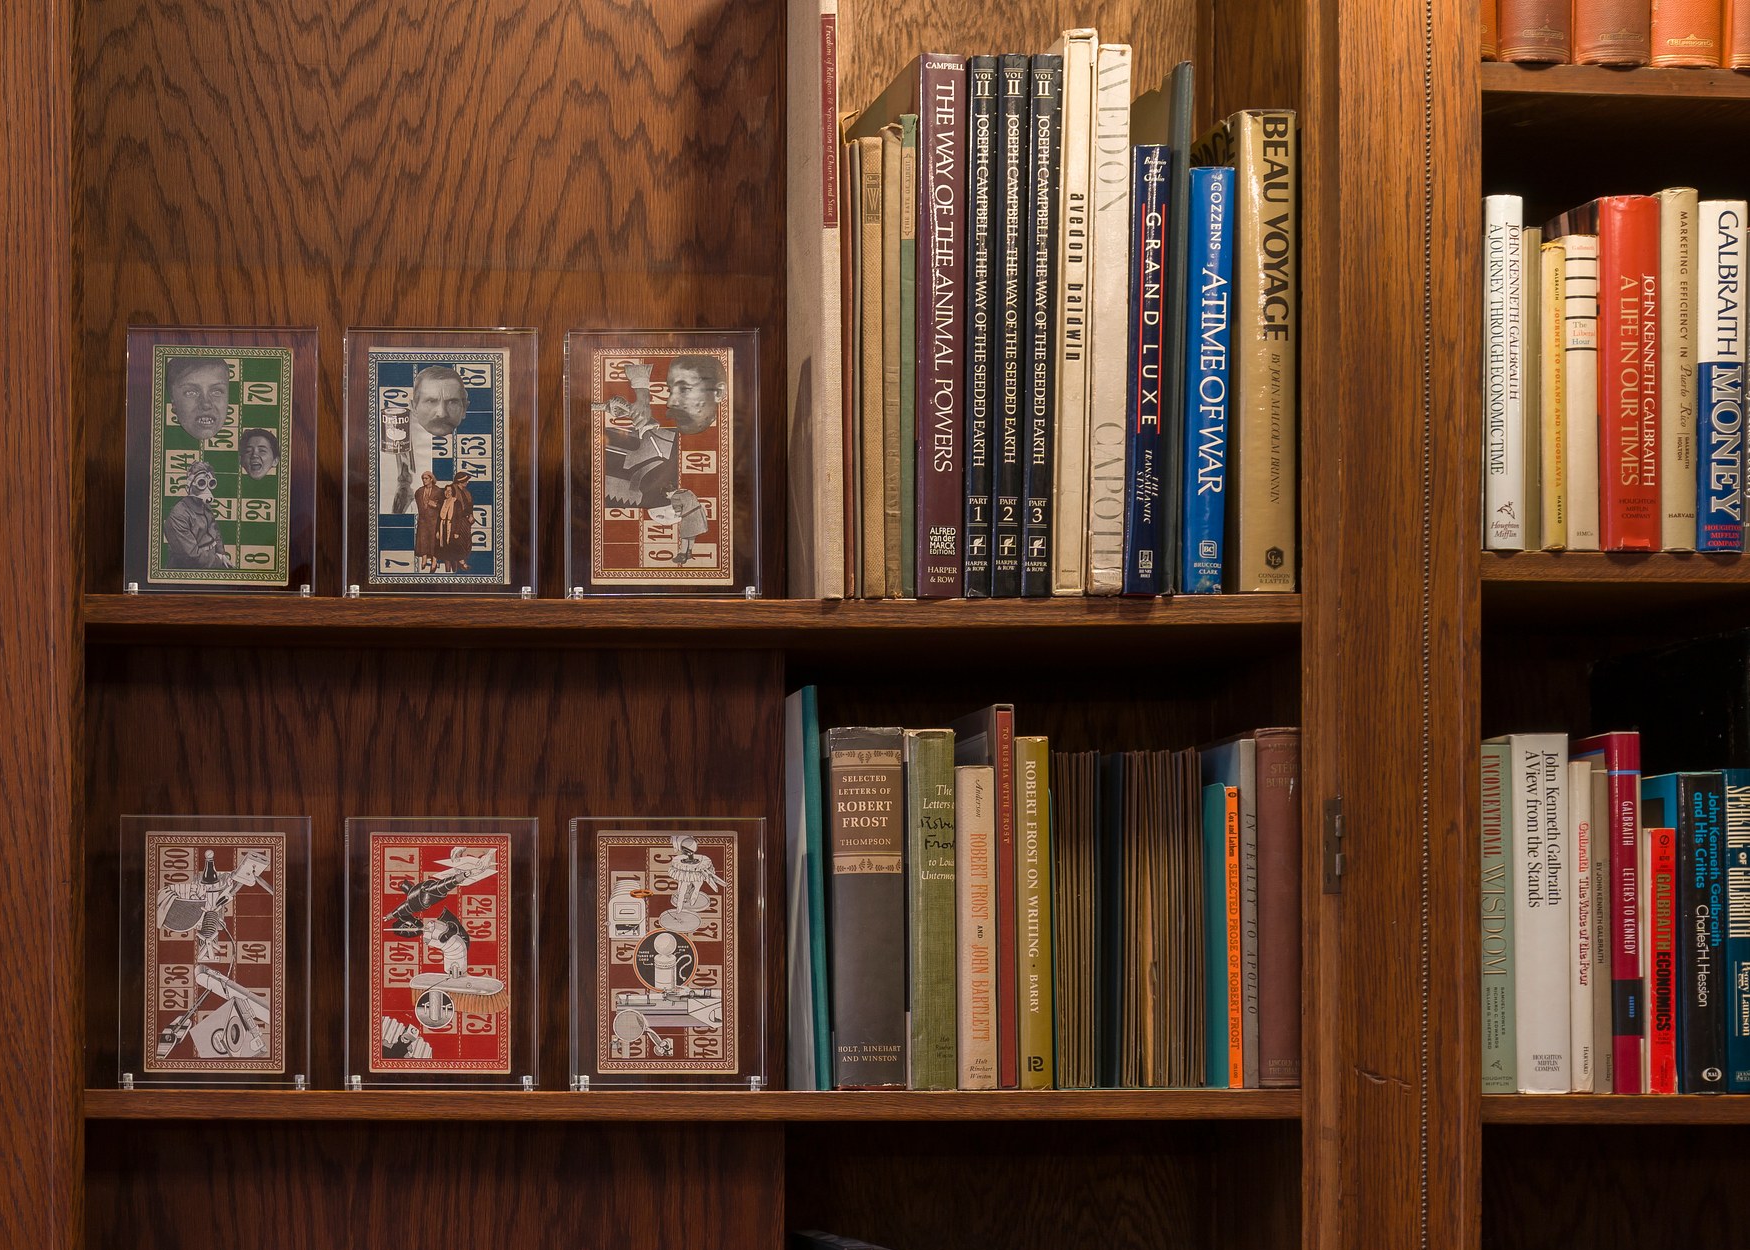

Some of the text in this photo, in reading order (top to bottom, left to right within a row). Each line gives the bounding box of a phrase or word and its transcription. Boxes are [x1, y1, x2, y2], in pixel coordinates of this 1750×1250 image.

[1262, 116, 1290, 342] BEAU VOYAGE
[933, 81, 955, 473] THE WAY OF THE ANIMAL POWERS
[1066, 193, 1086, 361] avedon baldwin
[1141, 212, 1161, 425] GRAND LUXE
[1198, 182, 1227, 496] COZZENS A TIME OF WAR
[460, 366, 487, 386] 87
[1711, 210, 1742, 521] GALBRAITH MONEY
[247, 383, 274, 405] 70
[461, 436, 487, 456] 53
[685, 451, 714, 473] 49
[247, 550, 272, 565] 8
[385, 558, 410, 567] 7
[837, 802, 892, 812] ROBERT
[842, 817, 888, 827] FROST
[1526, 750, 1543, 908] A View from the Stands
[1542, 751, 1562, 905] John Kenneth Galbraith
[163, 849, 190, 869] 80
[1025, 760, 1040, 1013] ROBERT FROST ON WRITING BARRY
[466, 898, 493, 918] 24
